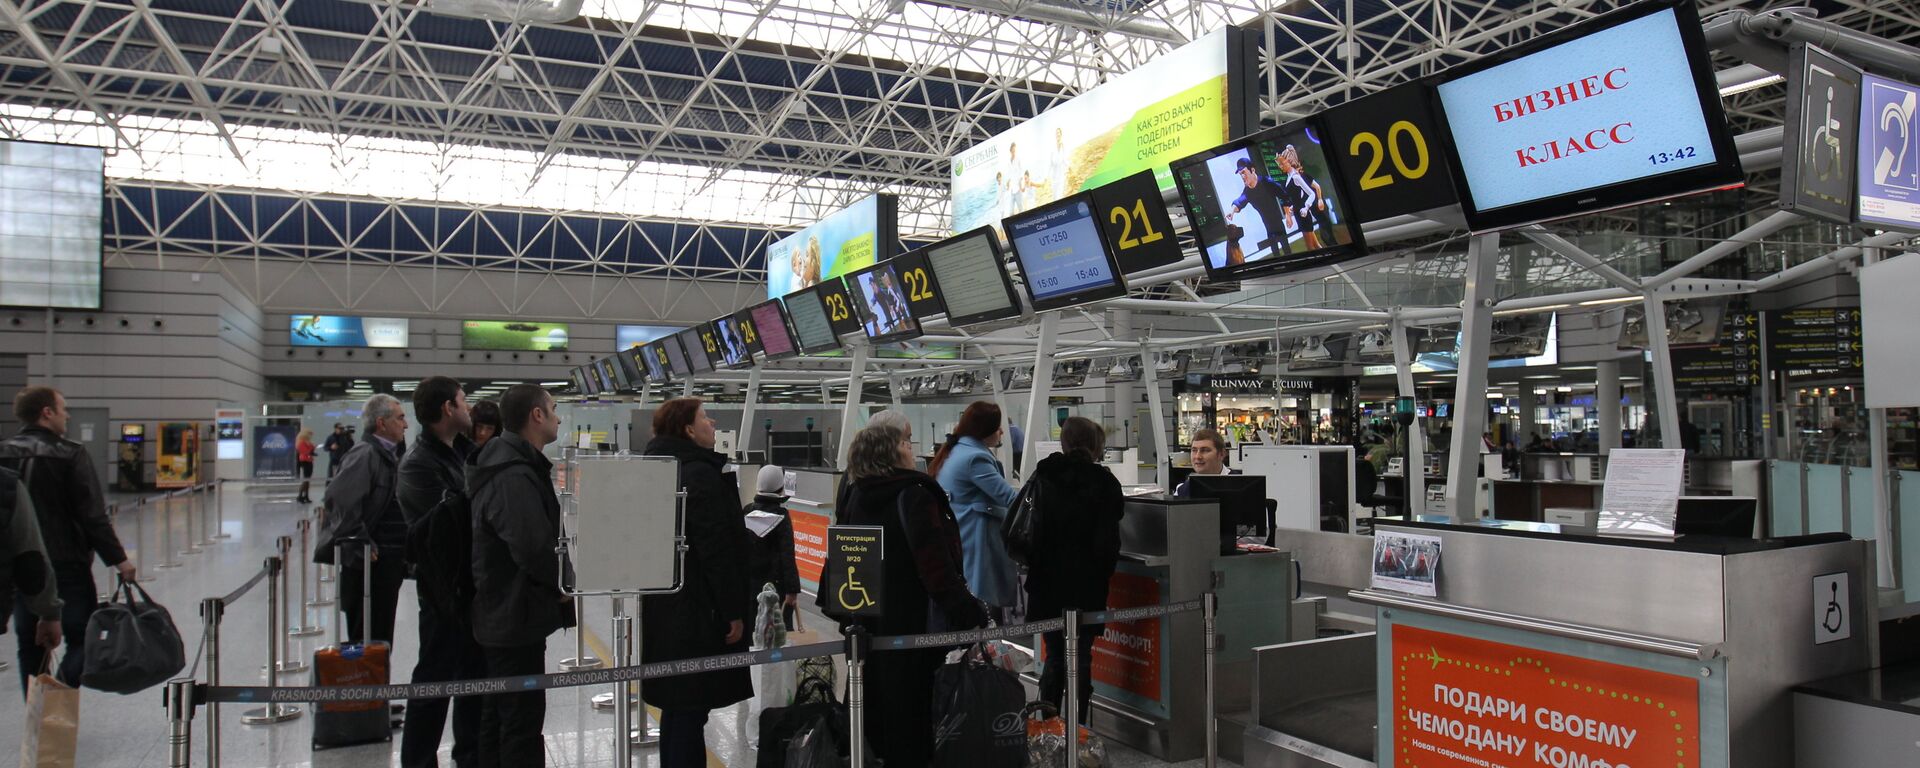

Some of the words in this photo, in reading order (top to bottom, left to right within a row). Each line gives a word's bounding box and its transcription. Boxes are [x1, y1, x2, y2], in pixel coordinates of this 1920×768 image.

[1492, 67, 1629, 123] БИЗНЕС
[1136, 120, 1152, 133] КАК
[1154, 111, 1170, 127] ЭТО
[1172, 97, 1205, 119] ВАЖНО
[1137, 116, 1193, 147] ПОДЕЛИТЬСЯ
[1515, 122, 1634, 168] КЛАСС
[1137, 136, 1180, 160] СЧАСТЬЕМ
[1349, 120, 1429, 191] 20
[1648, 146, 1696, 165] 13:42
[1038, 230, 1068, 247] UT-250
[1110, 198, 1163, 250] 21
[903, 267, 934, 302] 22
[1036, 276, 1058, 289] 15:00
[1075, 267, 1099, 281] 15:40
[826, 293, 849, 322] 23
[703, 332, 716, 353] 25
[740, 320, 757, 344] 24
[1211, 379, 1264, 389] RUNWAY
[1272, 380, 1313, 389] EXCLUSIVE
[836, 534, 876, 542] Регистрация
[1113, 607, 1148, 621] KRASNODAR
[914, 633, 957, 647] KRASNODAR
[959, 631, 980, 643] SOCHI
[982, 628, 1004, 640] ANAPA
[1005, 625, 1025, 636] YEISK
[1026, 619, 1064, 634] GELENDZHIK
[552, 671, 609, 687] KRASNODAR
[613, 667, 641, 681] SOCHI
[644, 663, 673, 677] ANAPA
[675, 660, 701, 673] YEISK
[703, 654, 757, 670] GELENDZHIK
[270, 688, 336, 702] KRASNODAR
[340, 687, 373, 700] SOCHI
[376, 685, 409, 699] ANAPA
[412, 683, 442, 697] YEISK
[445, 680, 507, 695] GELENDZHIK
[1434, 683, 1526, 724] ПОДАРИ
[1534, 707, 1636, 749] СВОЕМУ
[1408, 708, 1526, 757] ЧЕМОДАНУ
[1412, 738, 1436, 753] Новая
[1437, 746, 1489, 768] современная
